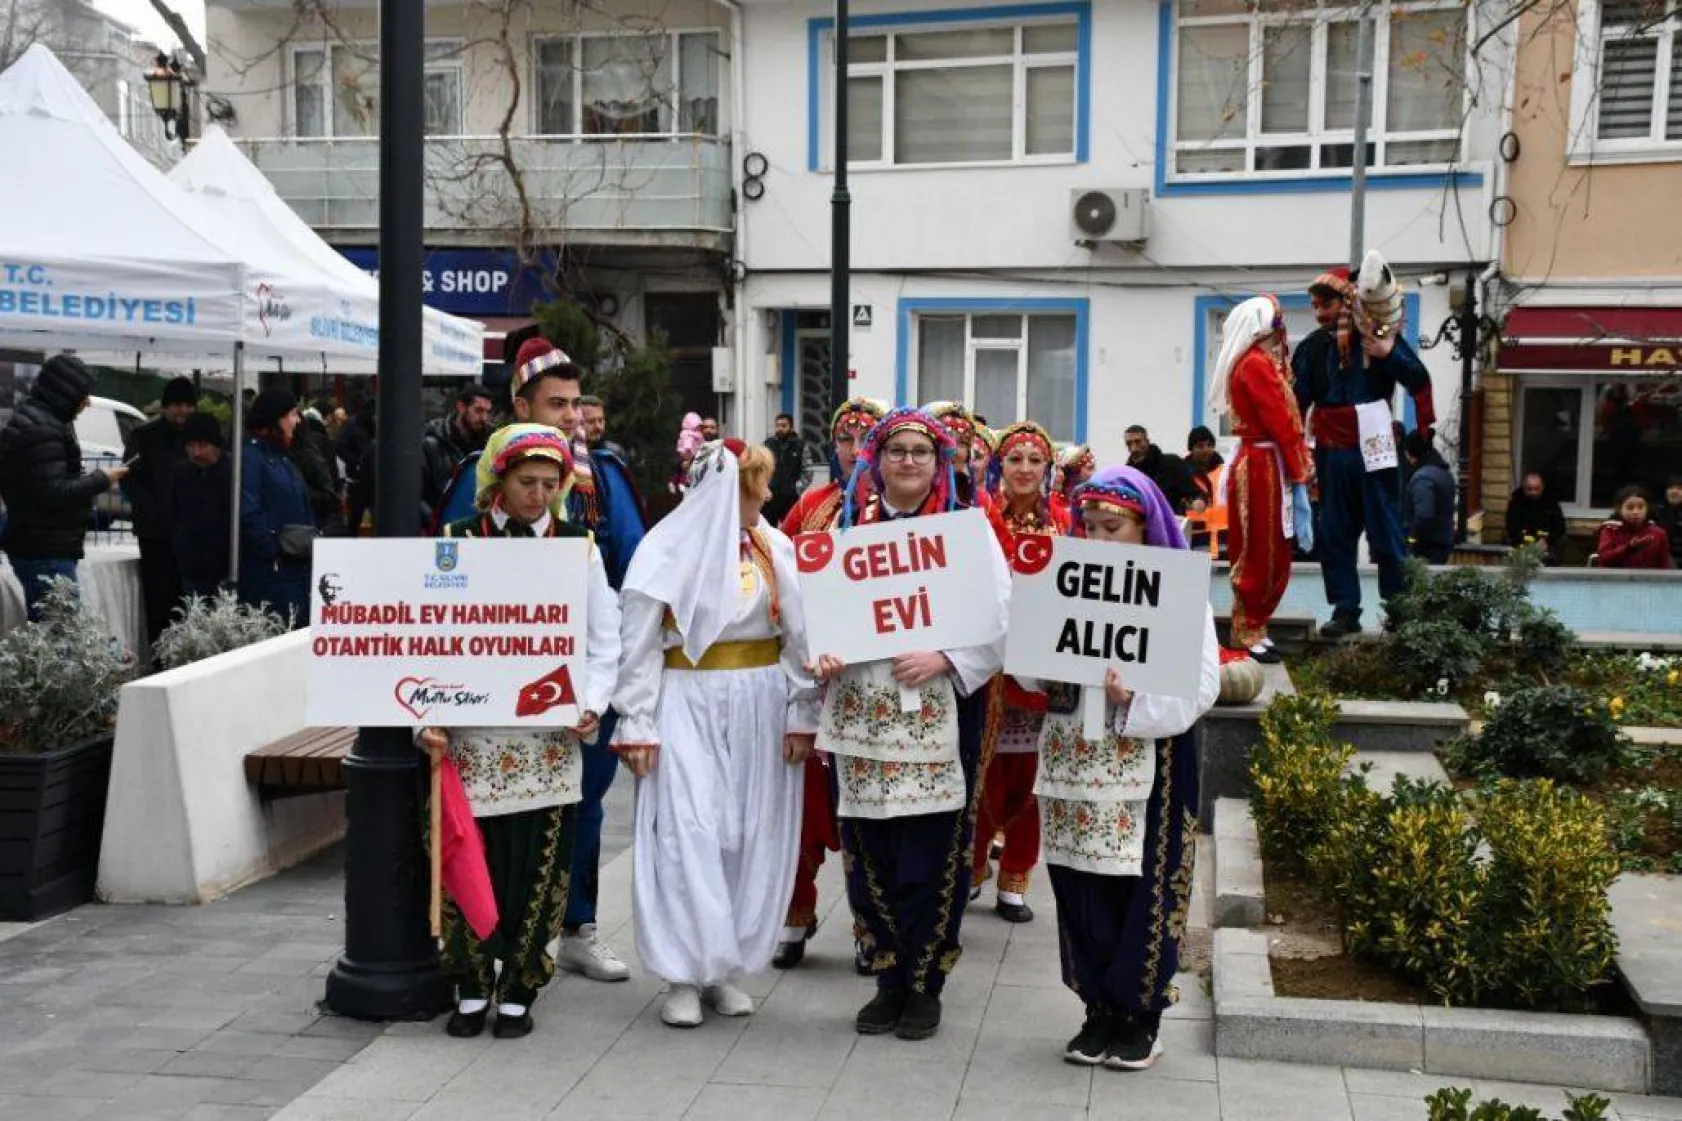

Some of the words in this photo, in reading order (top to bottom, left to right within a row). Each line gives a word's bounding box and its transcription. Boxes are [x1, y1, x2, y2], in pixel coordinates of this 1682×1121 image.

[3, 264, 53, 285] T.C.
[441, 270, 509, 292] SHOP
[0, 289, 196, 325] BELEDİYESİ
[1610, 348, 1682, 365] HA
[842, 532, 947, 581] GELİN
[1056, 560, 1162, 607] GELİN
[320, 601, 415, 625] MÜBADİL
[419, 604, 448, 625] EV
[452, 604, 569, 624] HANIMLARI
[872, 586, 932, 635] EVİ
[313, 633, 403, 657] OTANTİK
[408, 636, 465, 656] HALK
[468, 636, 575, 656] OYUNLARI
[1055, 618, 1149, 664] ALICI
